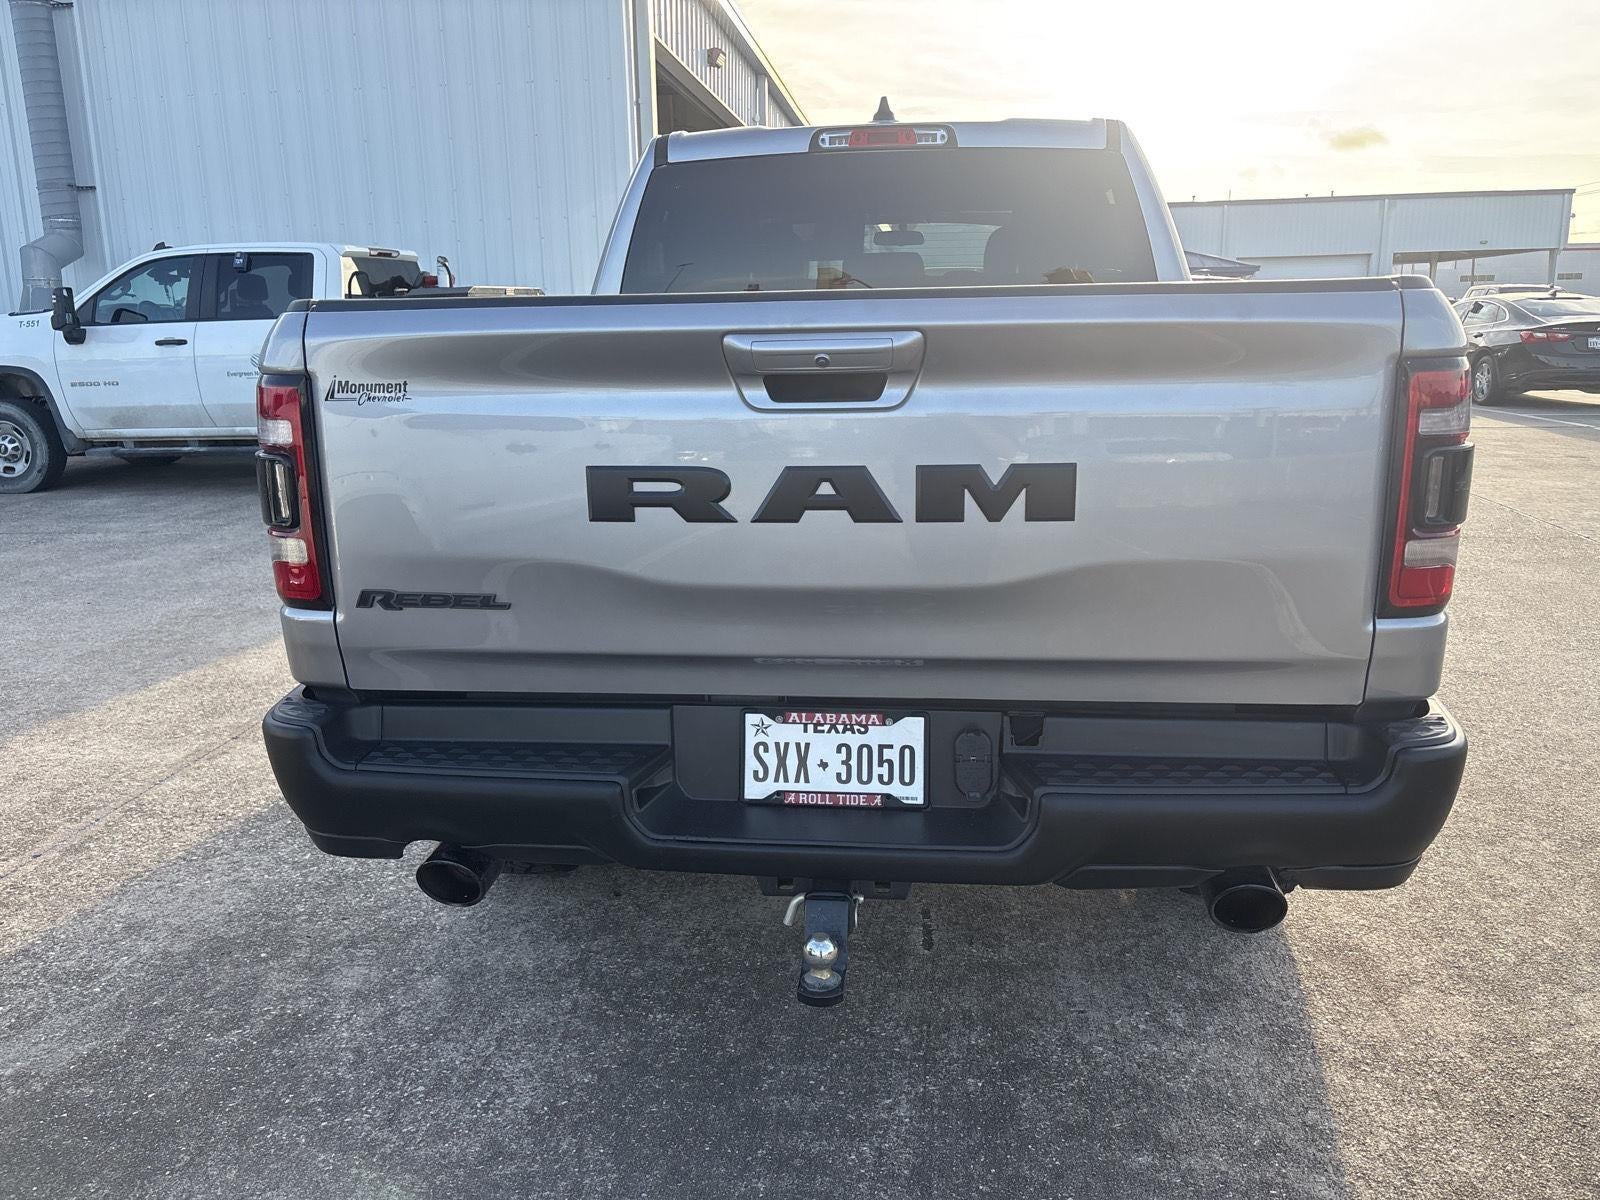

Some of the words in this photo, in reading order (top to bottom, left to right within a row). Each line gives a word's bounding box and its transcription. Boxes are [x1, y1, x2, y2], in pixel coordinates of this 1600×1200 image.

[18, 319, 40, 329] T-551
[226, 370, 254, 378] Evergreen
[336, 380, 409, 394] Monument
[357, 391, 412, 406] Chevrolet
[585, 462, 1078, 524] RAM
[355, 588, 513, 611] REBEL
[787, 712, 883, 726] ALABAMA
[802, 723, 870, 735] TEXAS
[752, 741, 811, 784] SXX
[835, 742, 916, 787] 3050
[799, 793, 834, 806] ROLL
[836, 794, 869, 807] TIDE
